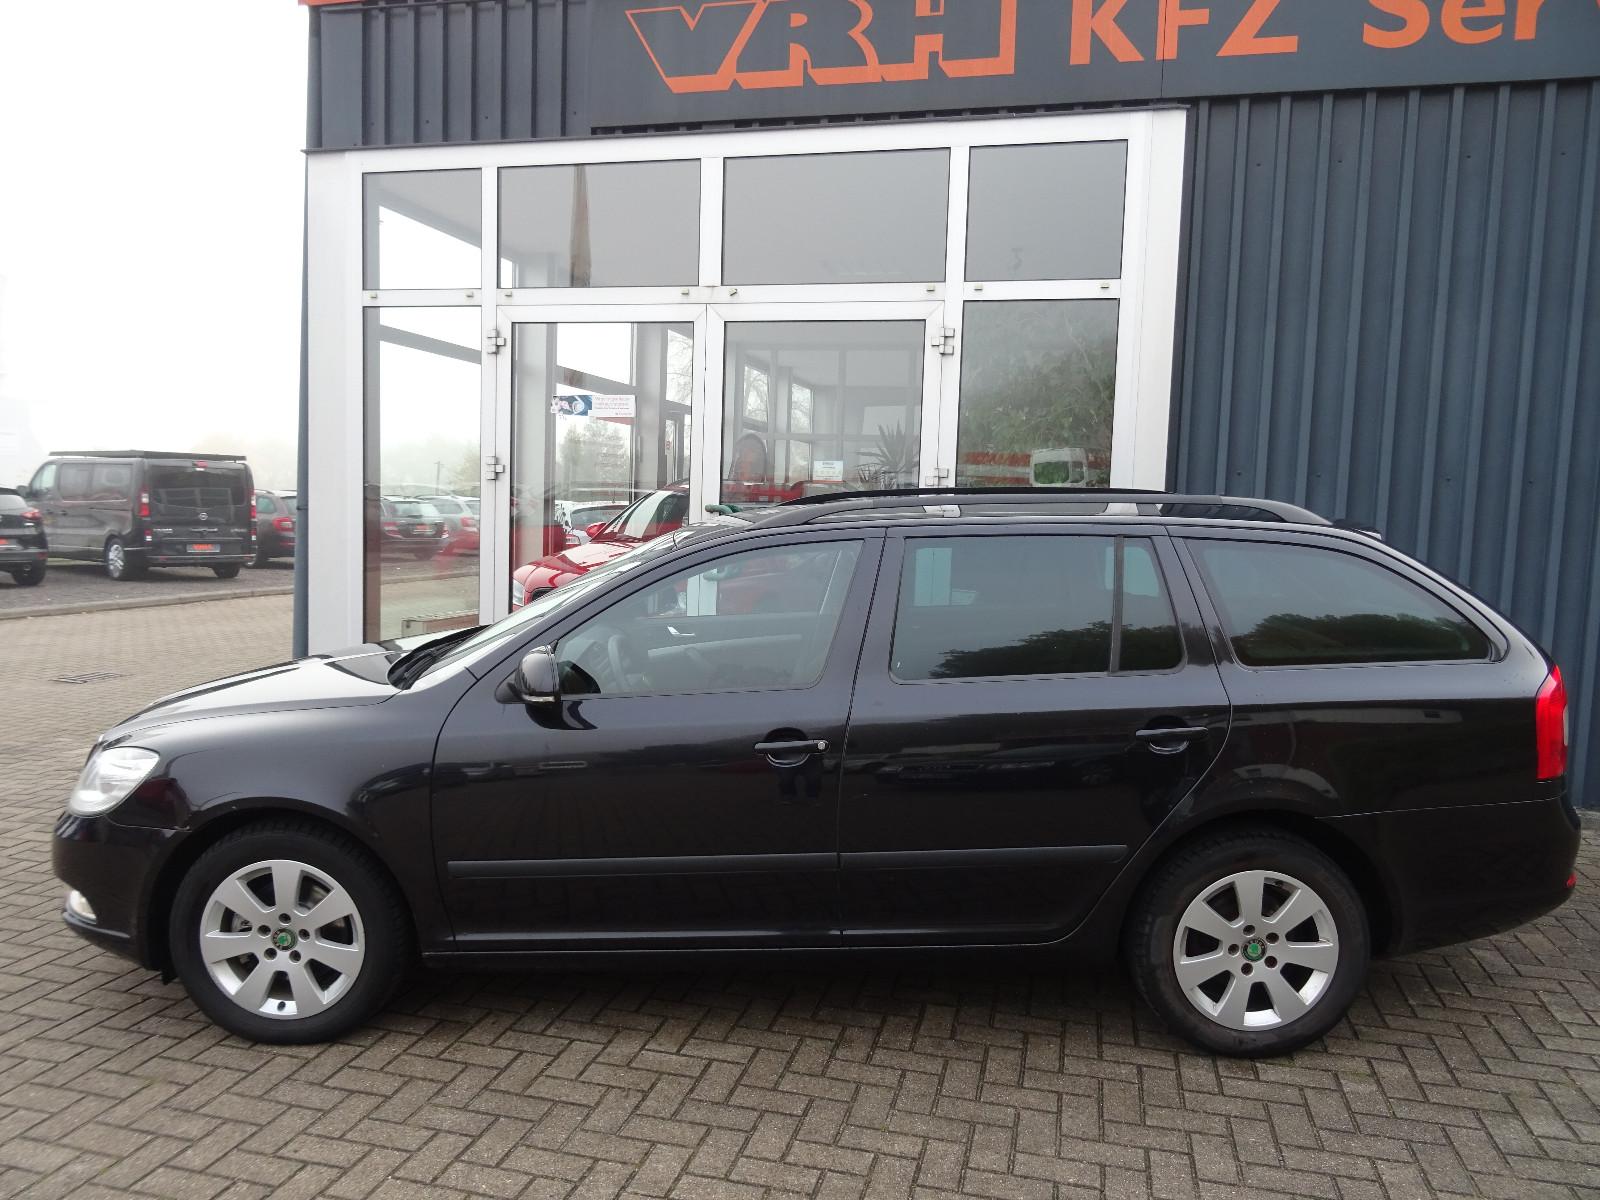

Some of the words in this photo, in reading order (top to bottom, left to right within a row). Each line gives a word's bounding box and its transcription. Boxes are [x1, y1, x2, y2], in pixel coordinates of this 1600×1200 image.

[626, 0, 1017, 93] VRH
[1069, 0, 1299, 65] KFZ
[1362, 0, 1600, 48] Ser
